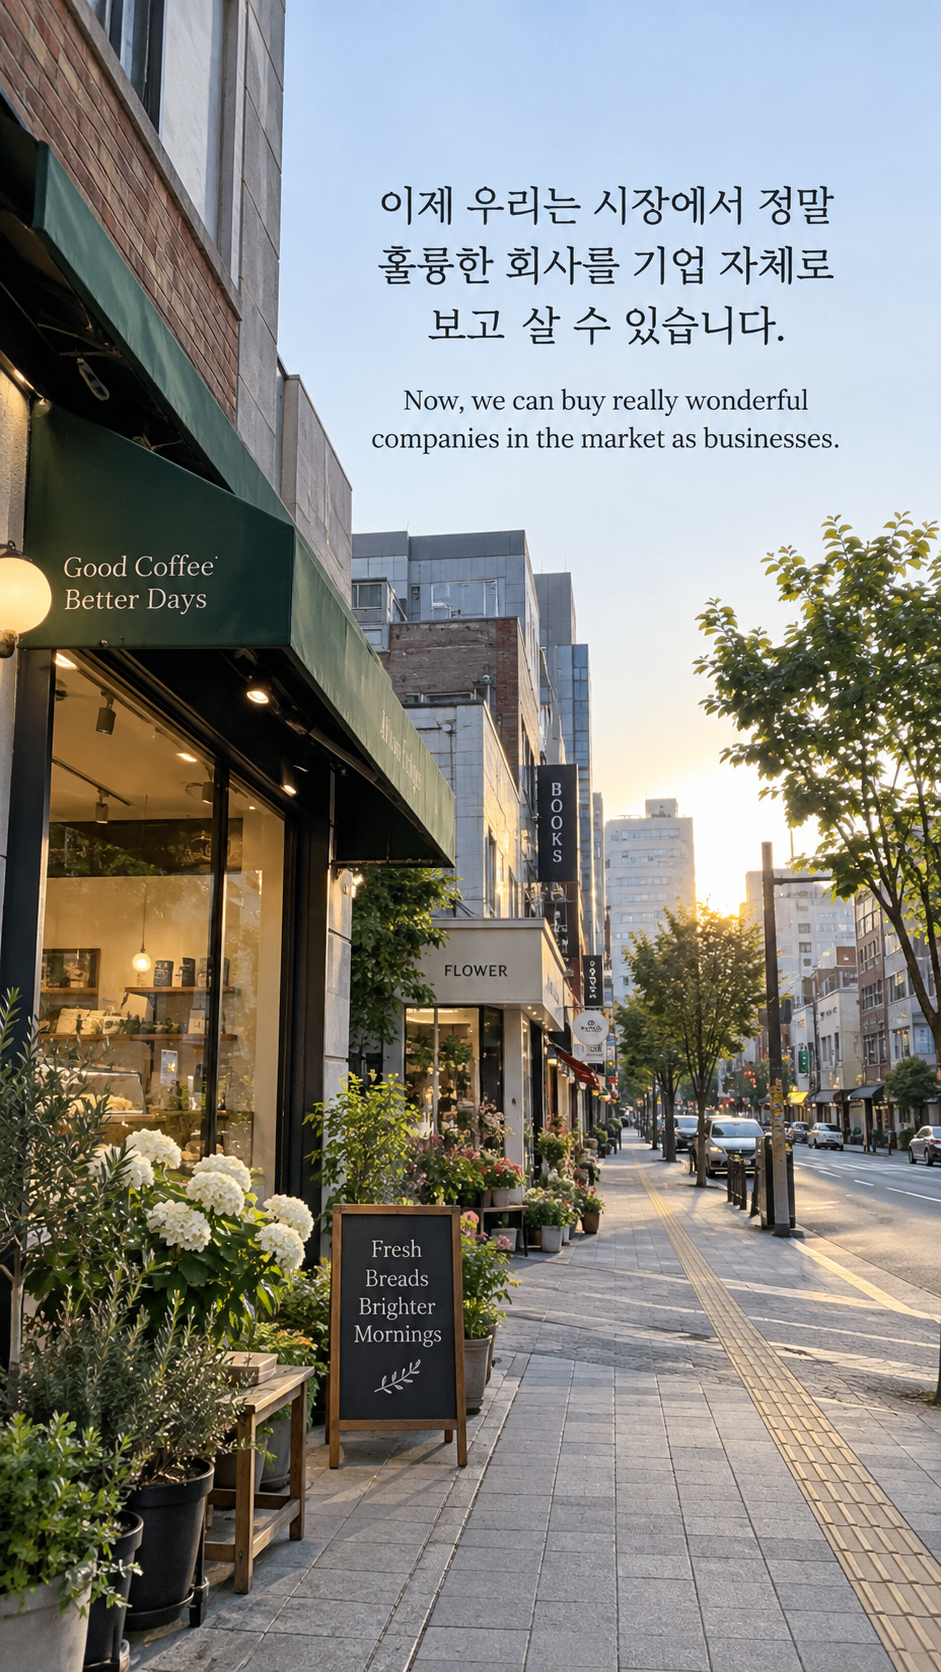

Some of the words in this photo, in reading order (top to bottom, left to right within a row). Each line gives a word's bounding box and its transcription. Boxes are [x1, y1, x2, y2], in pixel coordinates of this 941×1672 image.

[63, 555, 128, 578] Good
[134, 553, 215, 578] Coffee
[64, 588, 140, 611] Better
[146, 588, 207, 615] Days
[550, 782, 563, 863] BOOKS
[444, 964, 508, 977] FLOWER
[371, 1239, 422, 1258] Fresh
[365, 1268, 429, 1287] Breads
[358, 1296, 436, 1321] Brighter
[353, 1324, 442, 1348] Mornings
